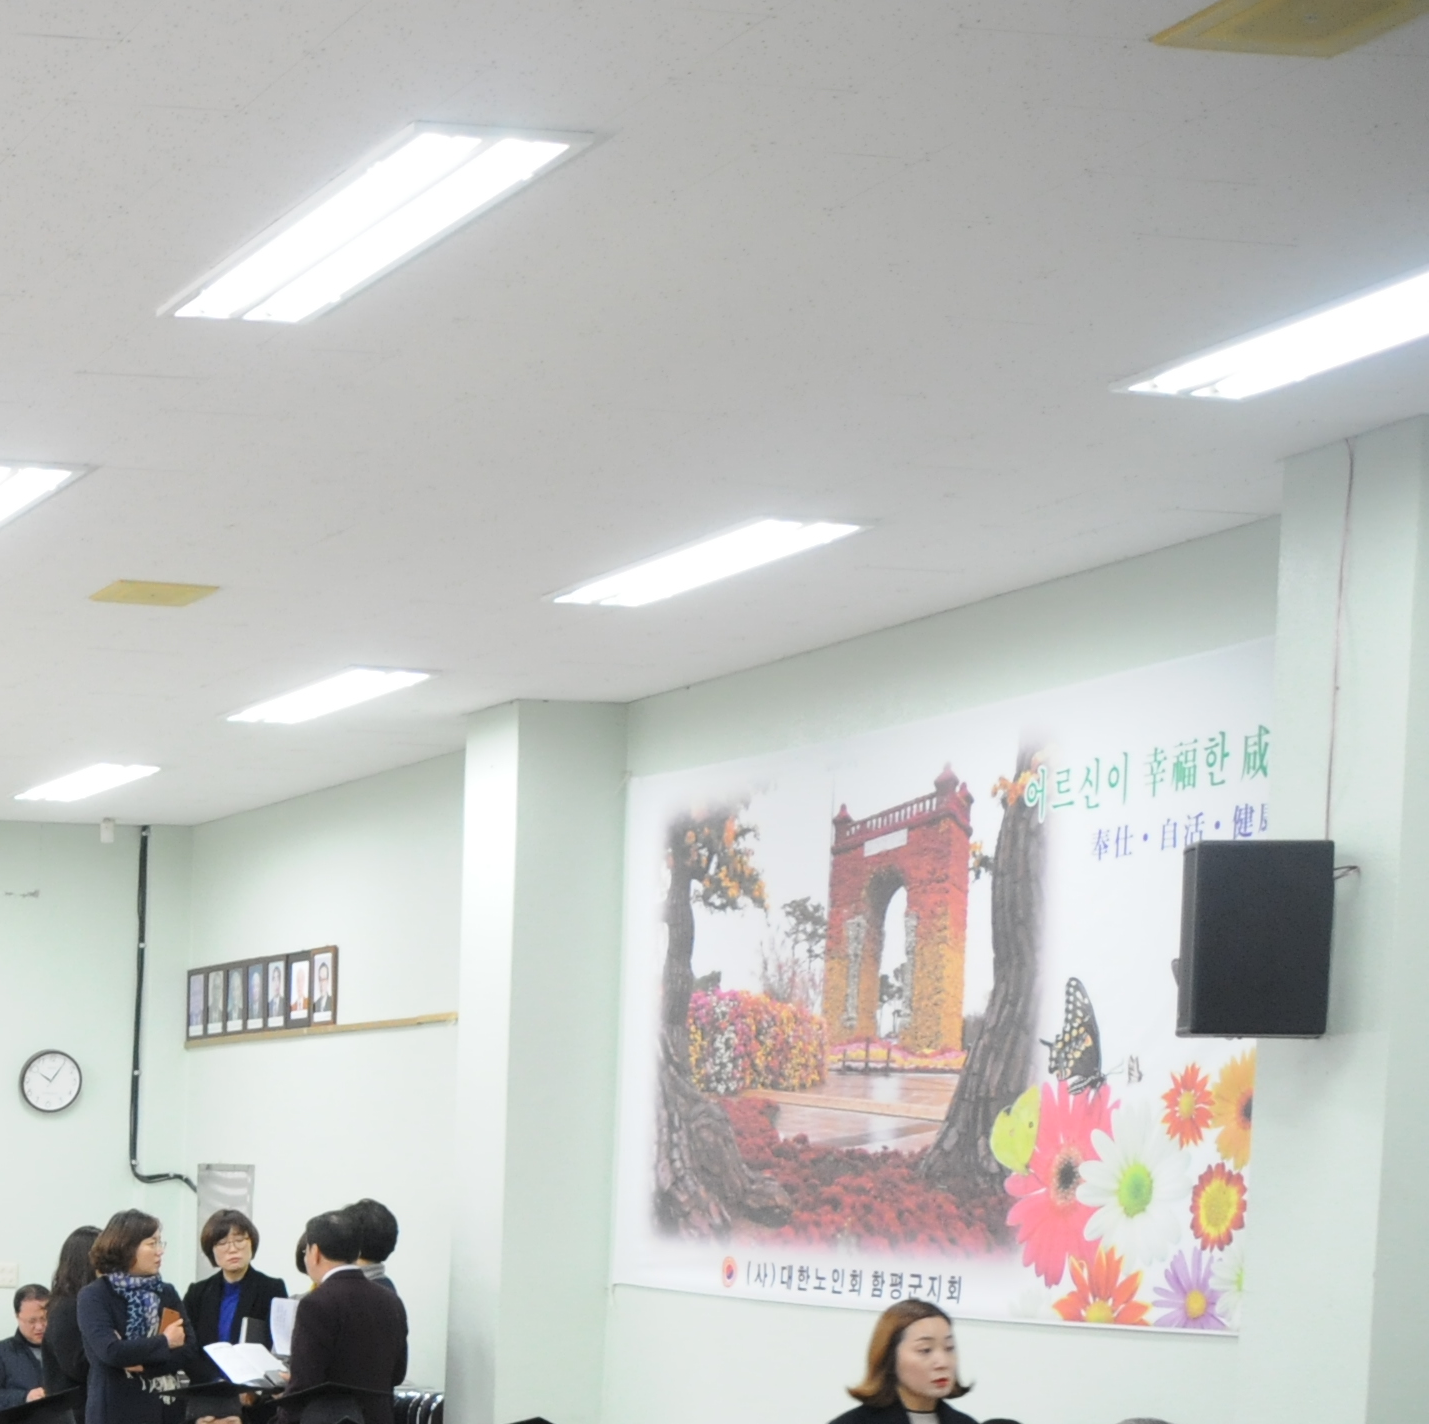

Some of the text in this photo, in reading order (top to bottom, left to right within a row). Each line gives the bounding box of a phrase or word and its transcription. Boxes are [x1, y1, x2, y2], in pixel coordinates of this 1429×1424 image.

[1026, 751, 1129, 822] 어르신이
[1144, 730, 1229, 797] 幸福한
[746, 1261, 963, 1304] (사)대한노인회 함평군지회
